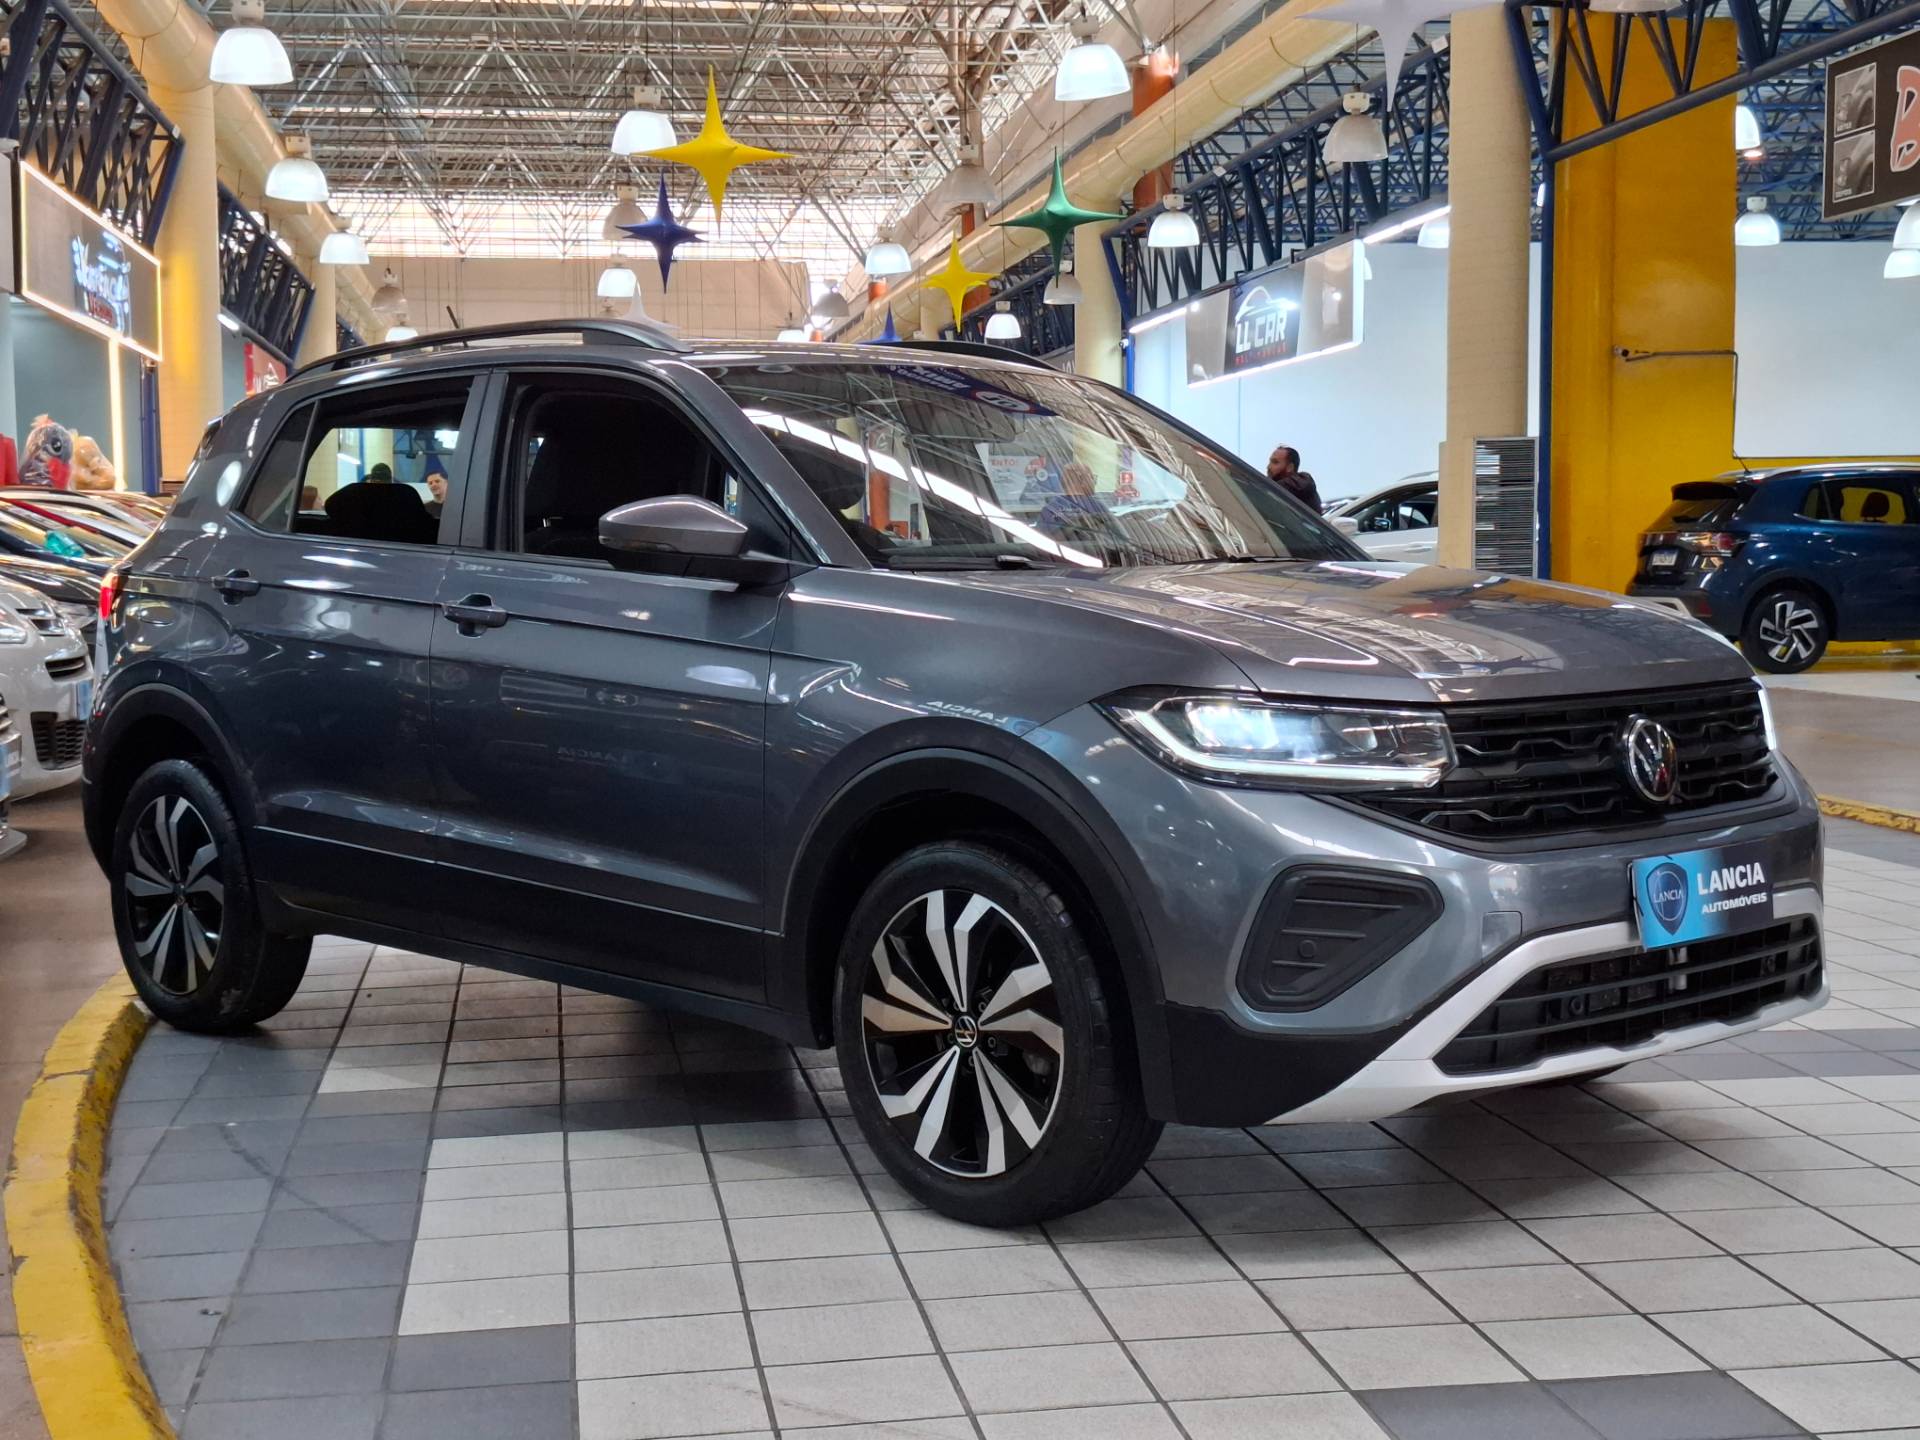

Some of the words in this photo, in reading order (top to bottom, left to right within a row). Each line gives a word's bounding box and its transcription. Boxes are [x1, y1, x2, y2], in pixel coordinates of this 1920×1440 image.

[1235, 320, 1251, 354] LL
[1254, 310, 1288, 348] CAR
[1697, 862, 1765, 895] LANCIA
[1653, 888, 1684, 904] LANCIA
[1702, 892, 1767, 914] AUTOMÓVEIS
